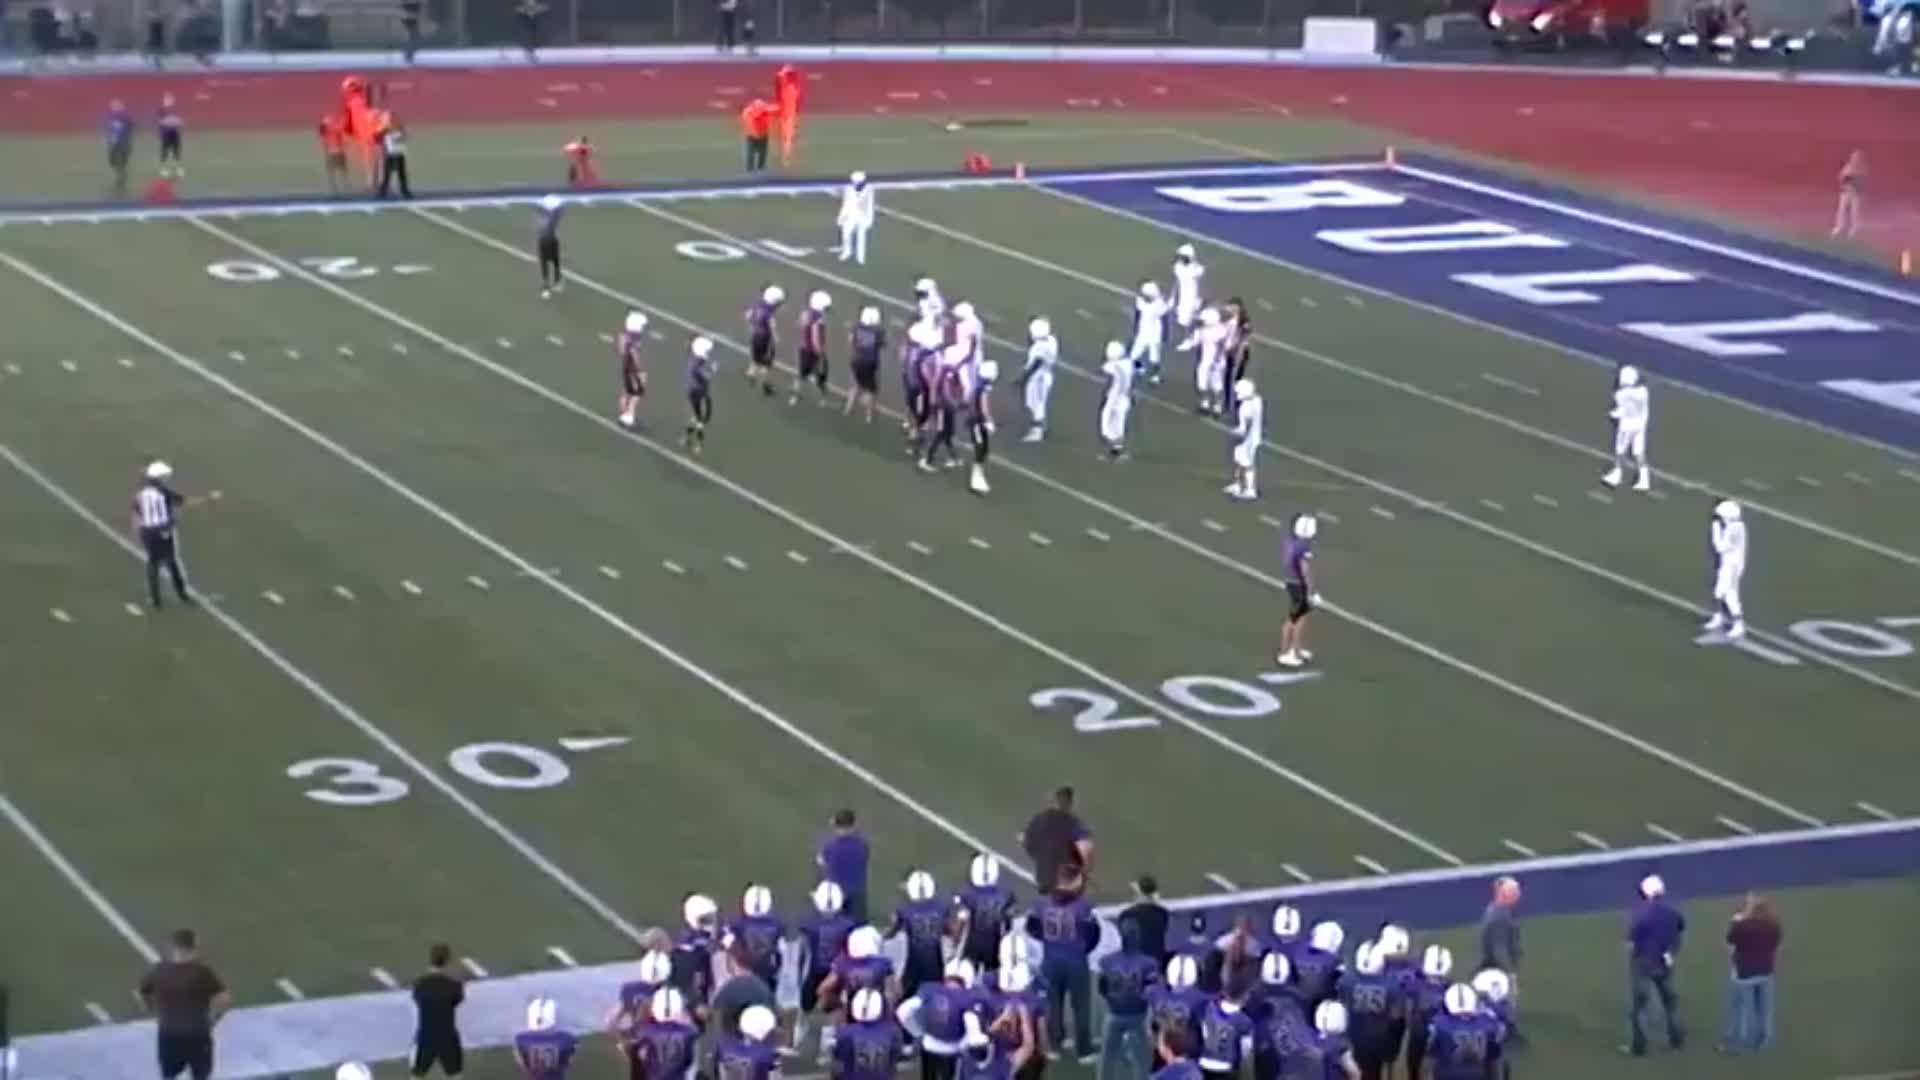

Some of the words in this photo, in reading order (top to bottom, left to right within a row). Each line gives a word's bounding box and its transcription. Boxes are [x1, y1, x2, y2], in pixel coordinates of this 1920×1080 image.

[1692, 620, 1914, 664] 10
[1029, 675, 1282, 732] 20
[286, 740, 570, 806] 30
